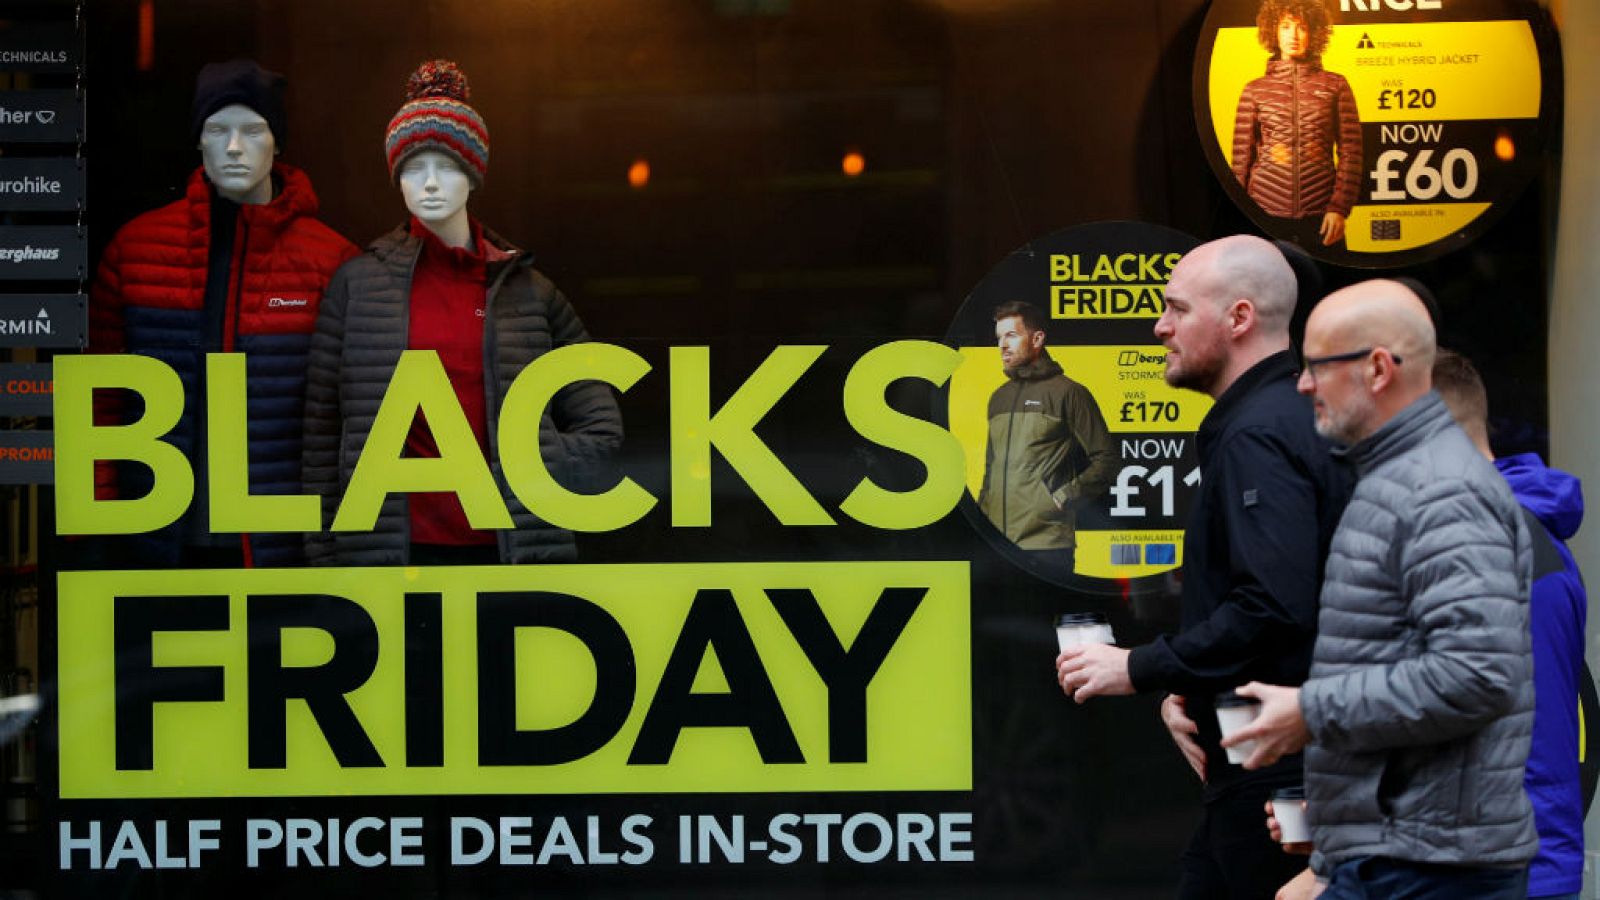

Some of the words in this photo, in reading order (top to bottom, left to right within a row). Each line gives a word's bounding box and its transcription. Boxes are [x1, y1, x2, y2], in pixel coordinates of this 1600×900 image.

[1439, 54, 1480, 64] JACKET
[1377, 88, 1437, 110] £120
[1380, 124, 1443, 145] NOW
[1370, 148, 1479, 200] £60
[1120, 401, 1180, 422] £170
[53, 339, 967, 535] BLACKS
[1121, 439, 1185, 459] NOW
[113, 587, 930, 772] FRIDAY
[60, 819, 221, 870] HALF
[246, 816, 425, 868] PRICE
[450, 814, 655, 867] DEALS
[679, 812, 974, 865] IN-STORE
